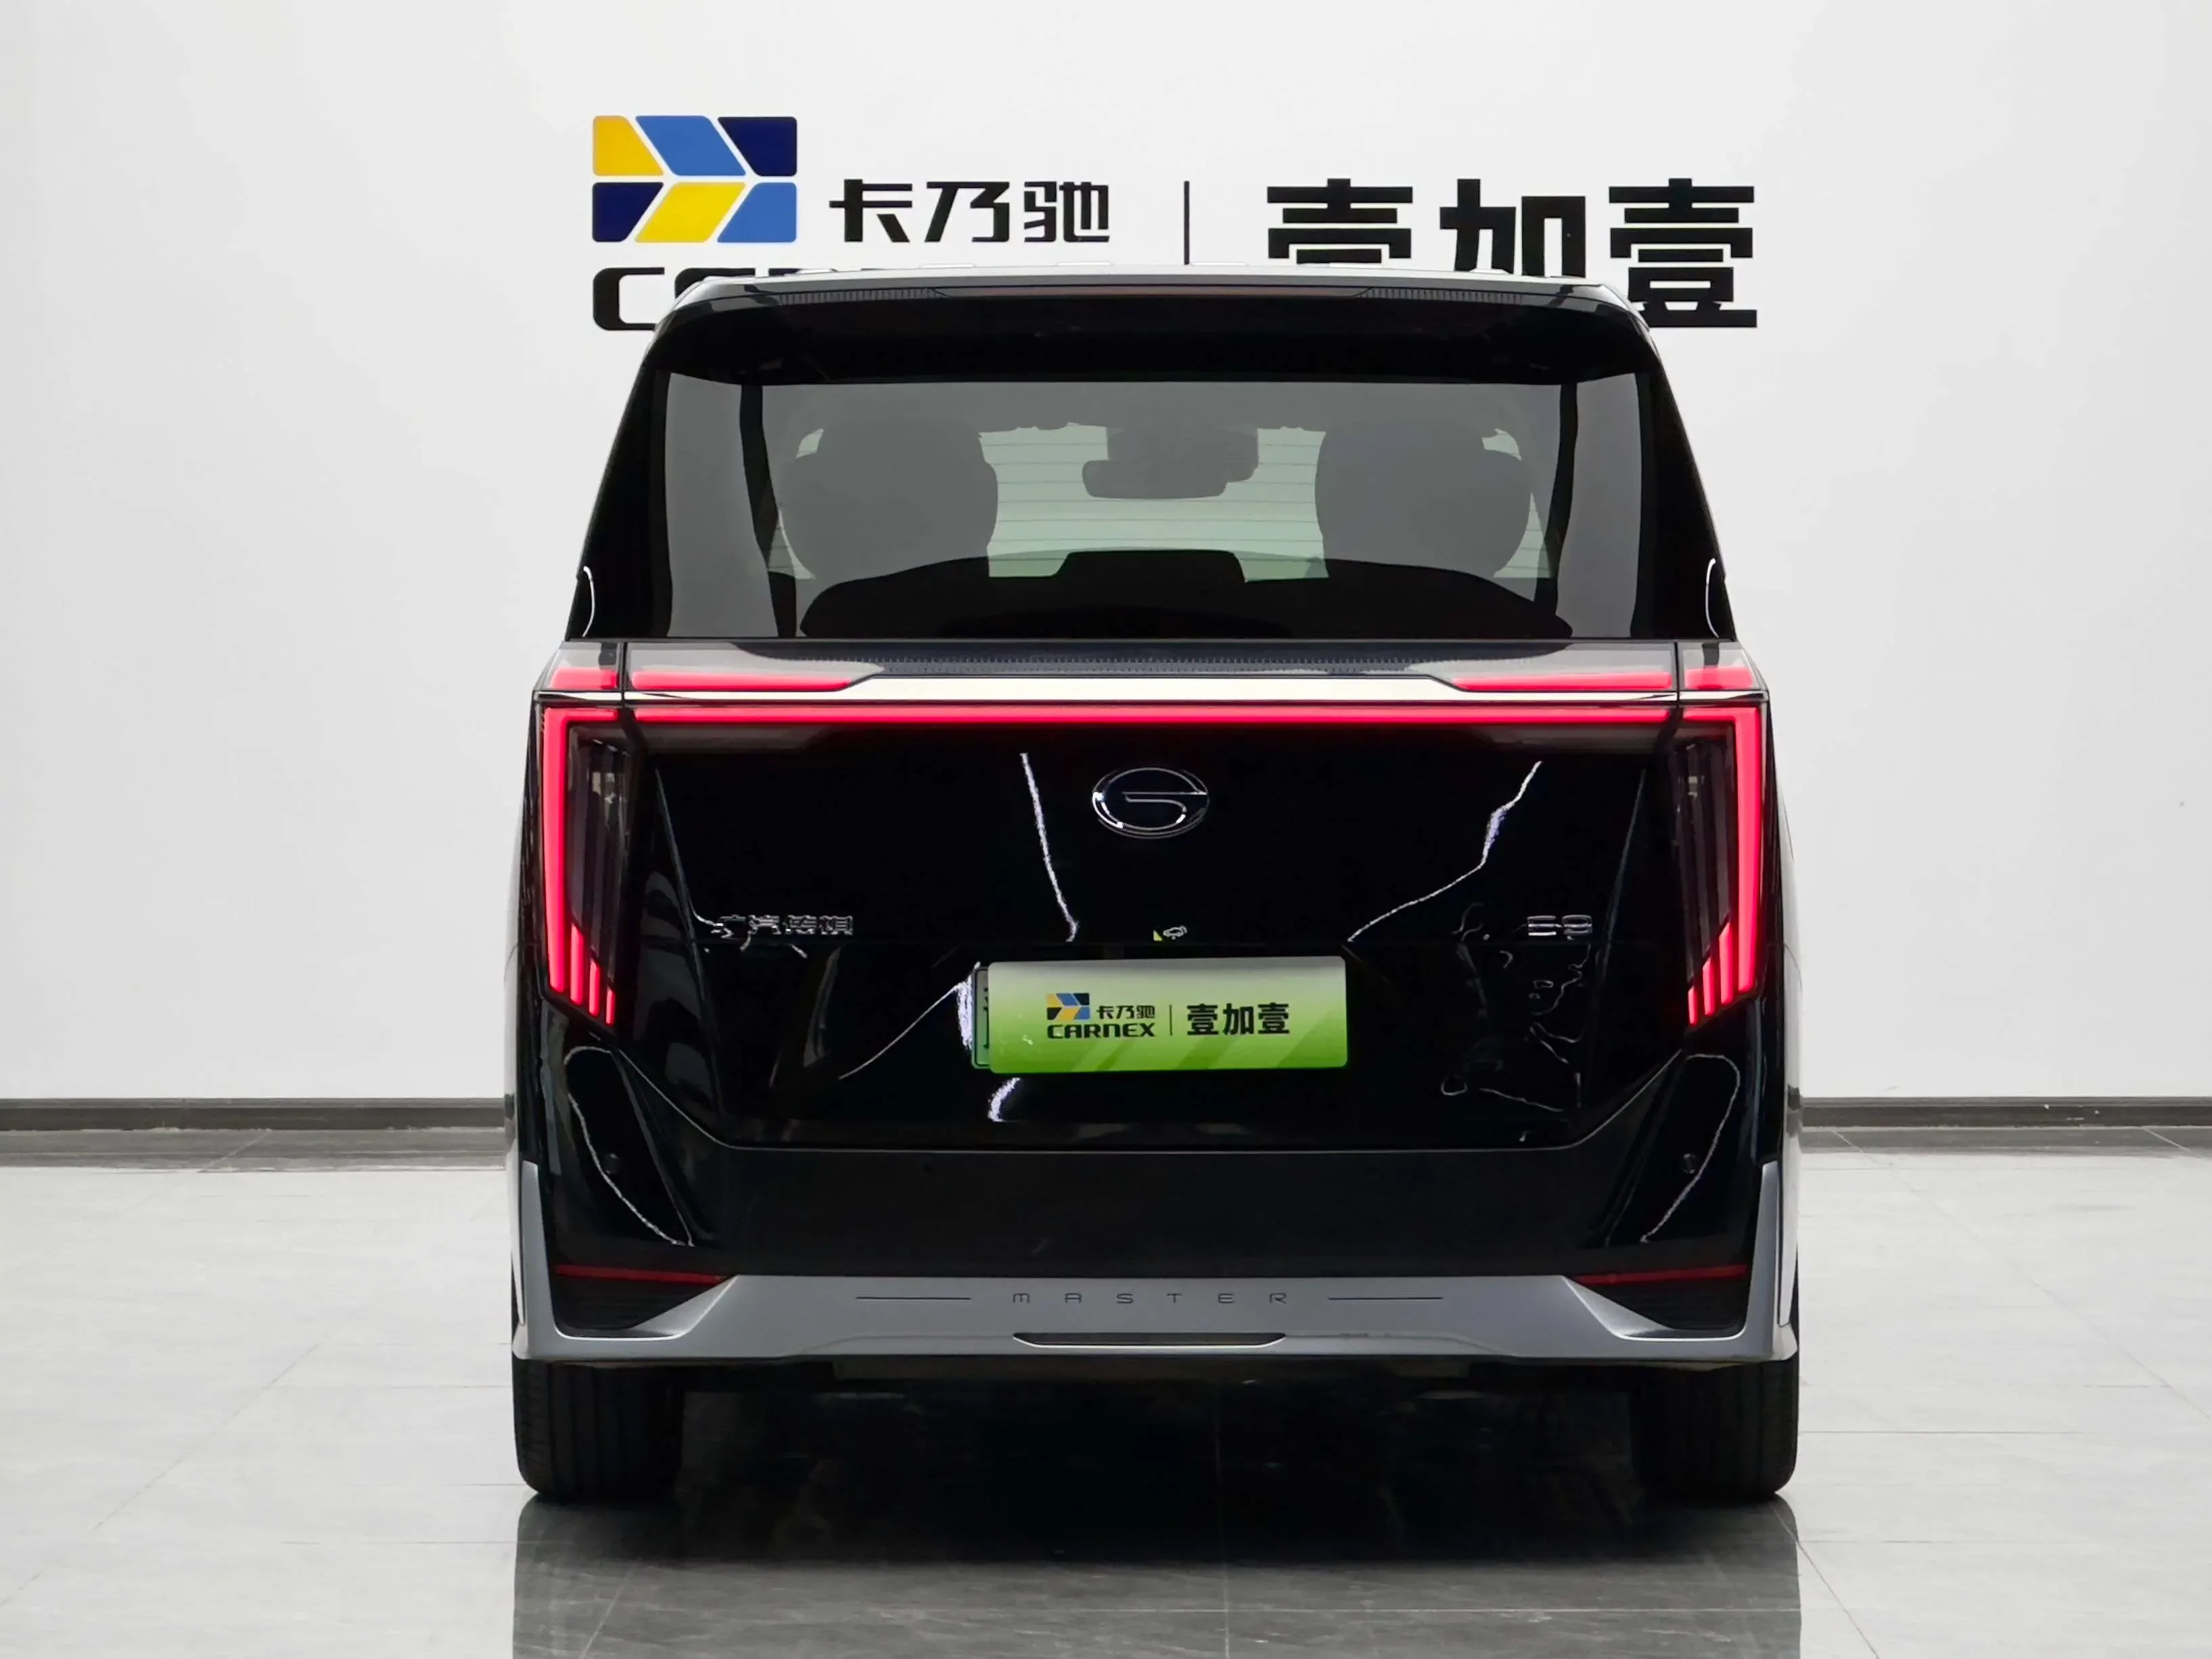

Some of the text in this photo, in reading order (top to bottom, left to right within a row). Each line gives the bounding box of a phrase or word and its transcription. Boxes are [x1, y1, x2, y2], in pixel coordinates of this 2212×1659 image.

[829, 179, 1110, 243] 卡乃驰
[1046, 1022, 1156, 1039] CARNEX
[1186, 1002, 1291, 1037] 壹加壹
[1012, 1292, 1287, 1304] MASTER
